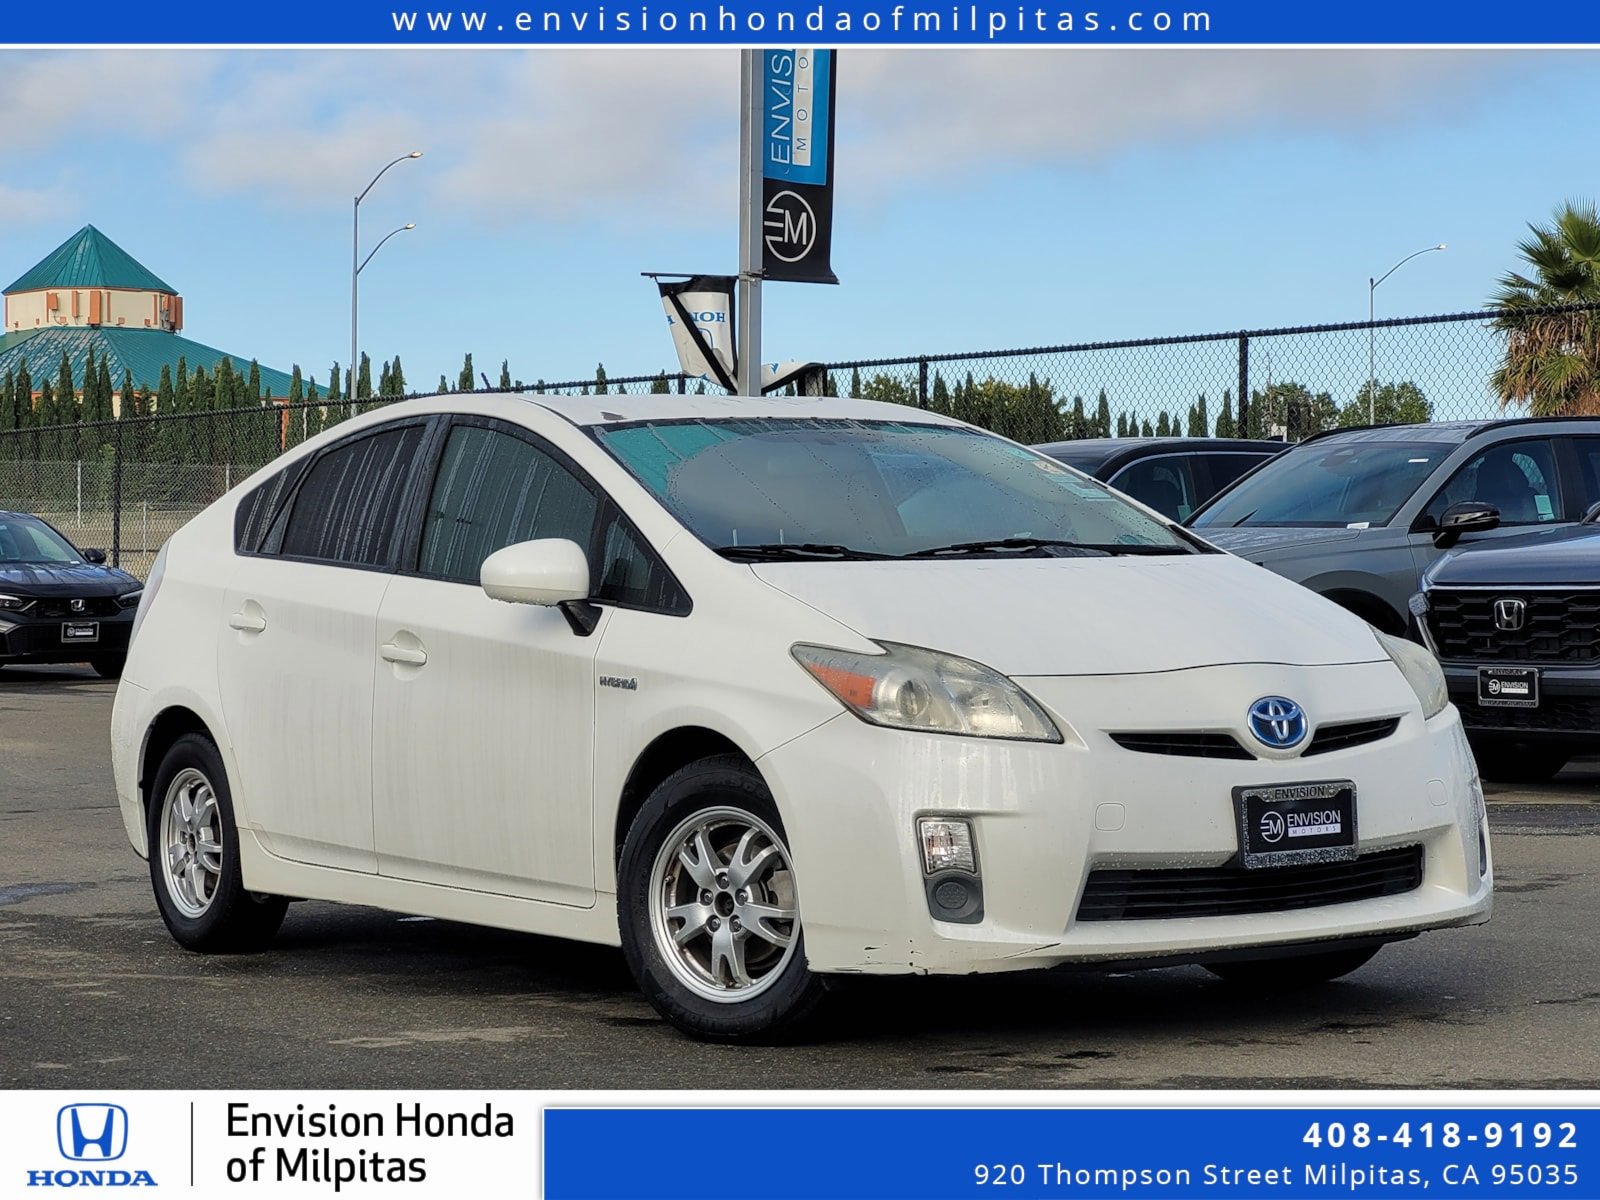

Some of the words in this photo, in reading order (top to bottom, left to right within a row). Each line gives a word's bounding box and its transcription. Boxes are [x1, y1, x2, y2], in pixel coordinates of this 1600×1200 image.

[1501, 681, 1529, 689] ENVISION
[1274, 786, 1326, 799] ENVISION
[1287, 810, 1341, 827] ENVISION
